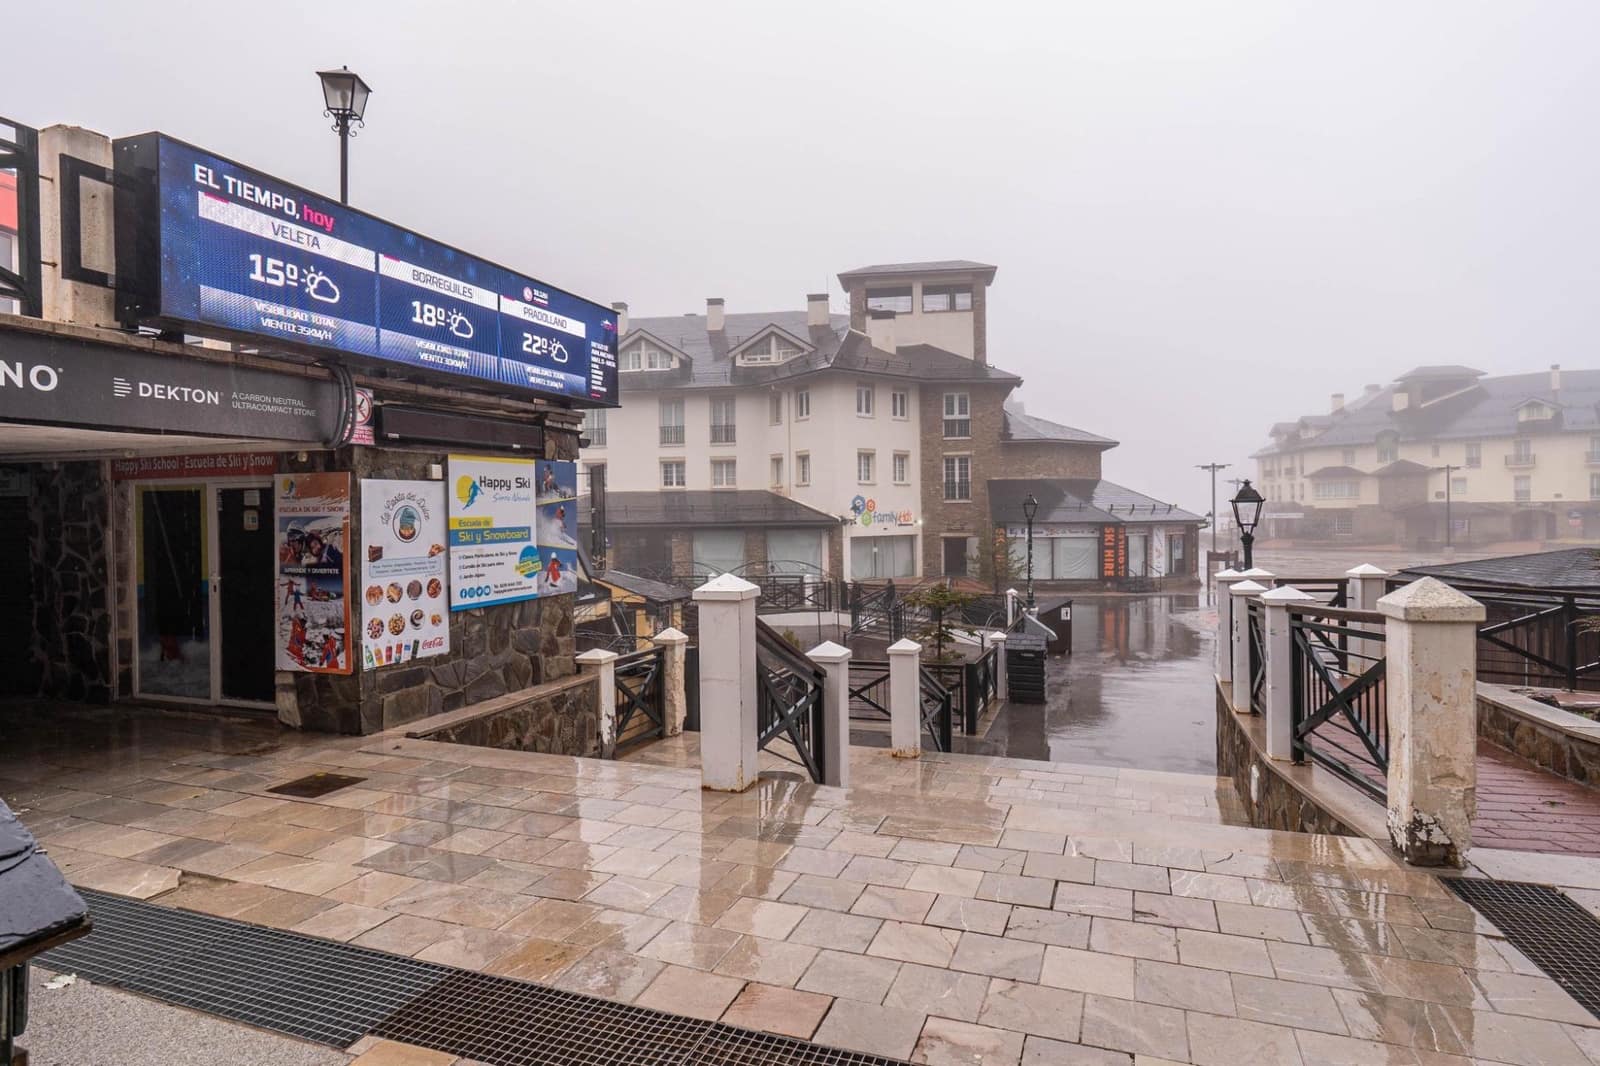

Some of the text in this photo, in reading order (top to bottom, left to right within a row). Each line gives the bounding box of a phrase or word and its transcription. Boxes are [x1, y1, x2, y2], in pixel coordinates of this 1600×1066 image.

[194, 164, 334, 232] EL TIEMPO, hoy
[272, 222, 320, 250] VELETA
[412, 269, 473, 299] BORREGUILES
[523, 306, 568, 329] PRADOLLANO
[138, 382, 219, 405] DEKTON
[232, 392, 306, 408] A CARBON NEUTRAL
[232, 400, 316, 417] ULTRACOMPACT STONE
[115, 460, 138, 474] Happy
[140, 458, 152, 470] Ski
[154, 458, 179, 470] School
[184, 456, 214, 469] Escuela
[216, 456, 226, 468] de
[228, 454, 240, 466] Ski
[242, 457, 248, 470] y
[250, 454, 273, 466] Snow
[479, 476, 531, 490] Happy Ski
[458, 529, 528, 543] Ski y Snowboard
[1104, 527, 1114, 576] SKI HIRE
